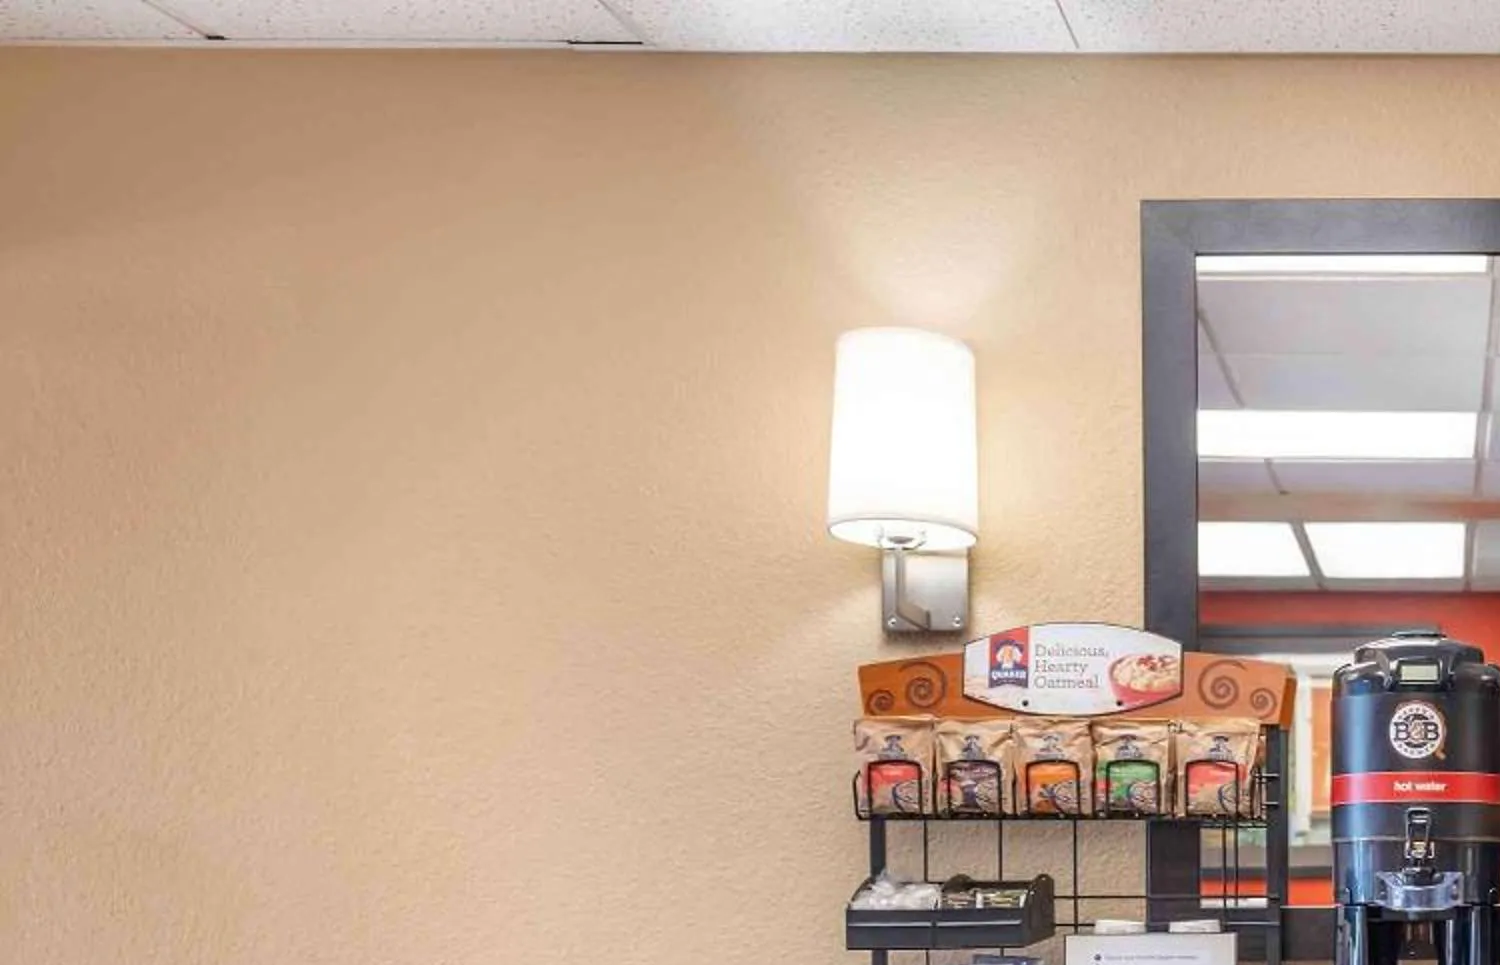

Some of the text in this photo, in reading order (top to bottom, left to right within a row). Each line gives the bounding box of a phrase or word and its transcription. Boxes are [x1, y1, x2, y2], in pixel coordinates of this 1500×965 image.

[1034, 643, 1109, 658] Delicious,
[1034, 659, 1089, 675] Hearty
[1034, 674, 1100, 689] Oatmeal
